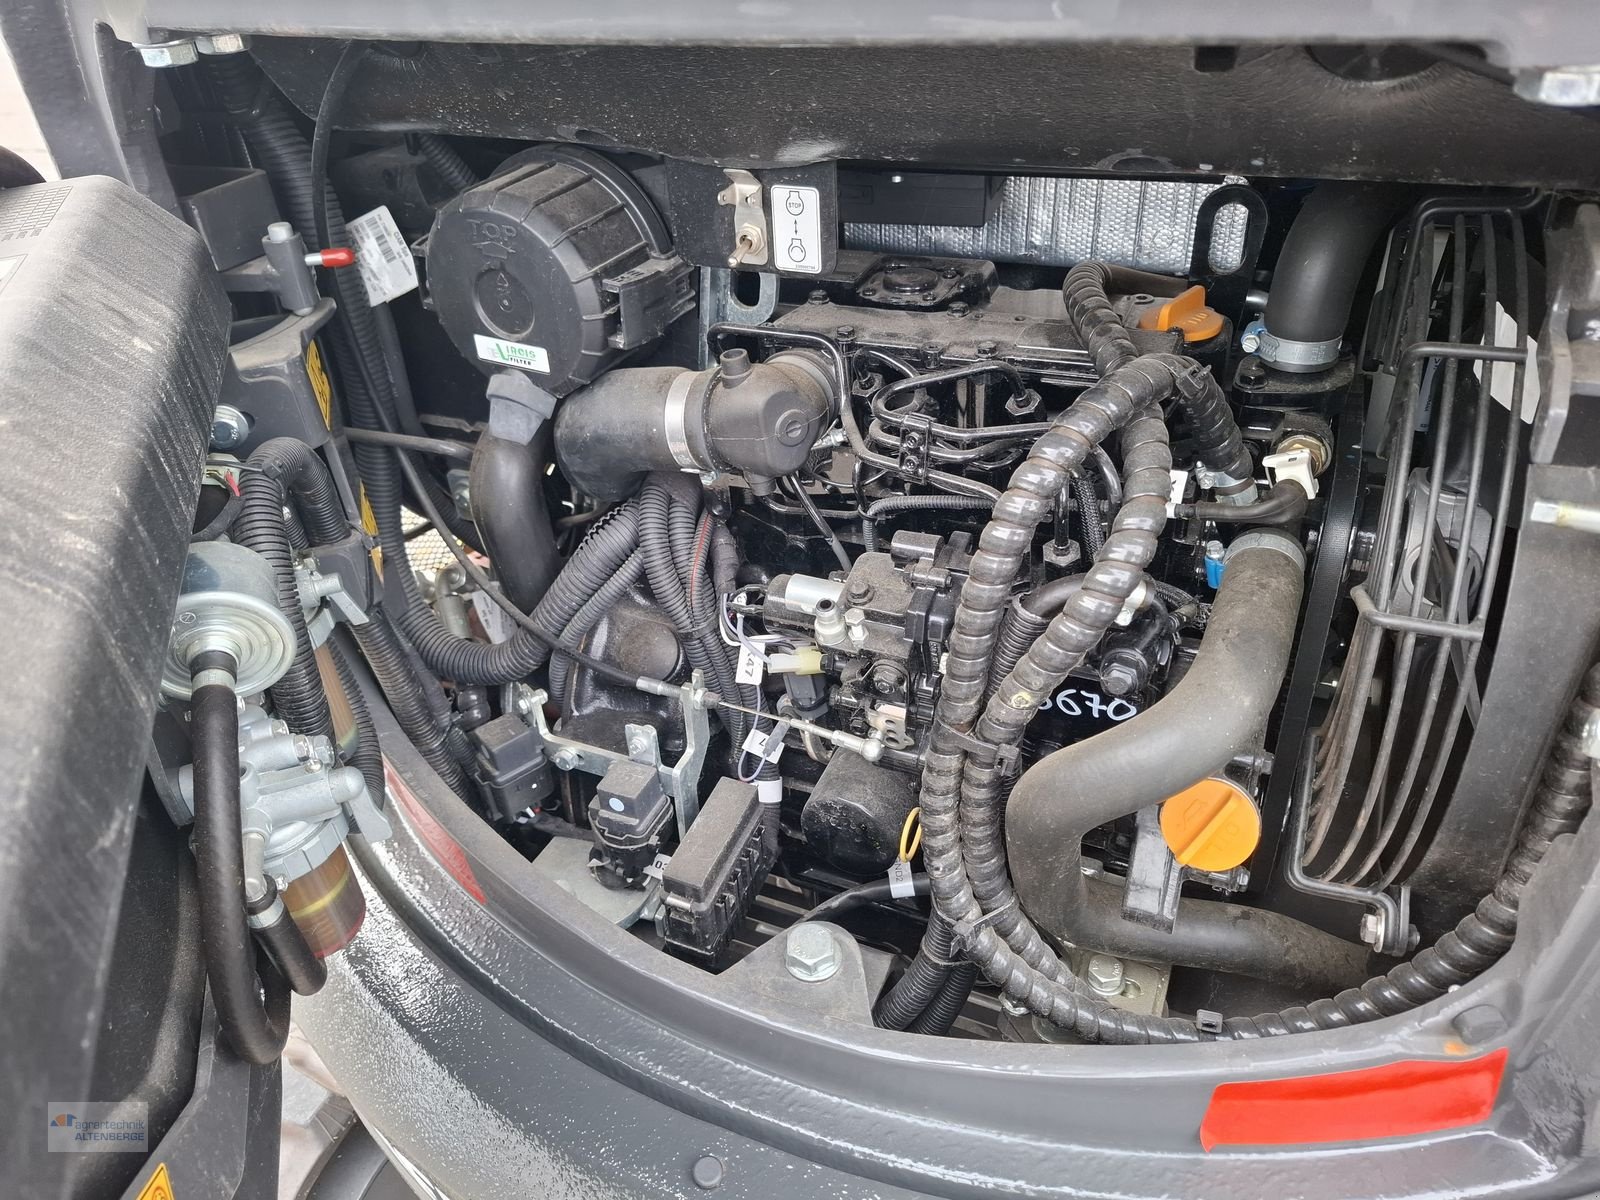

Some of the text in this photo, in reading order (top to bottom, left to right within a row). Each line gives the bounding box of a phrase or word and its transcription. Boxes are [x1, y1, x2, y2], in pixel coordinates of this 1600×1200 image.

[788, 202, 802, 210] STOP
[466, 218, 518, 241] TOP
[510, 357, 531, 366] FILTER
